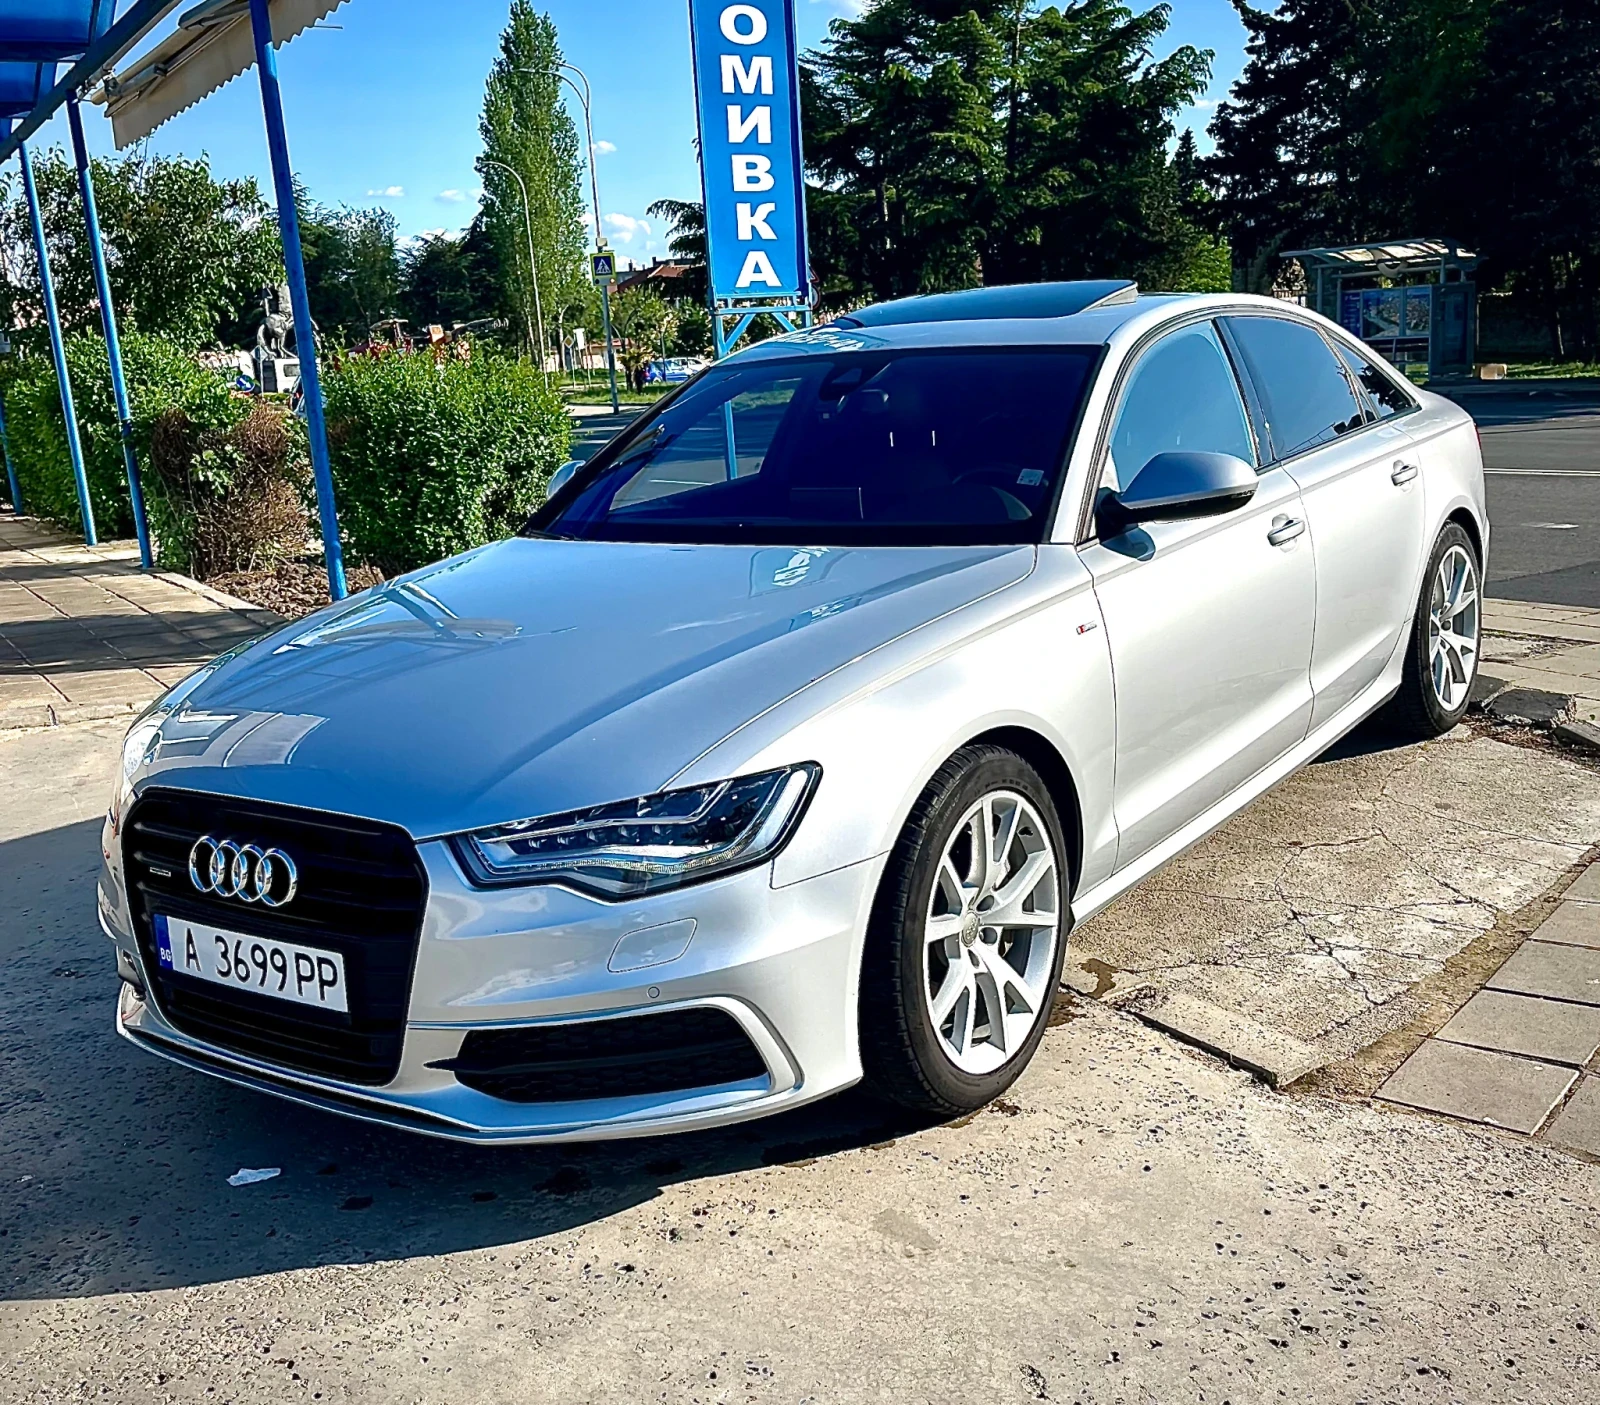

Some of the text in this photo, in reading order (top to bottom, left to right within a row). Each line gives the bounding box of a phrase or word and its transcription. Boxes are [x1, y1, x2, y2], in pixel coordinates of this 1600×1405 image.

[719, 4, 782, 287] ОМИВКА
[160, 947, 171, 961] BG
[186, 928, 201, 971] A
